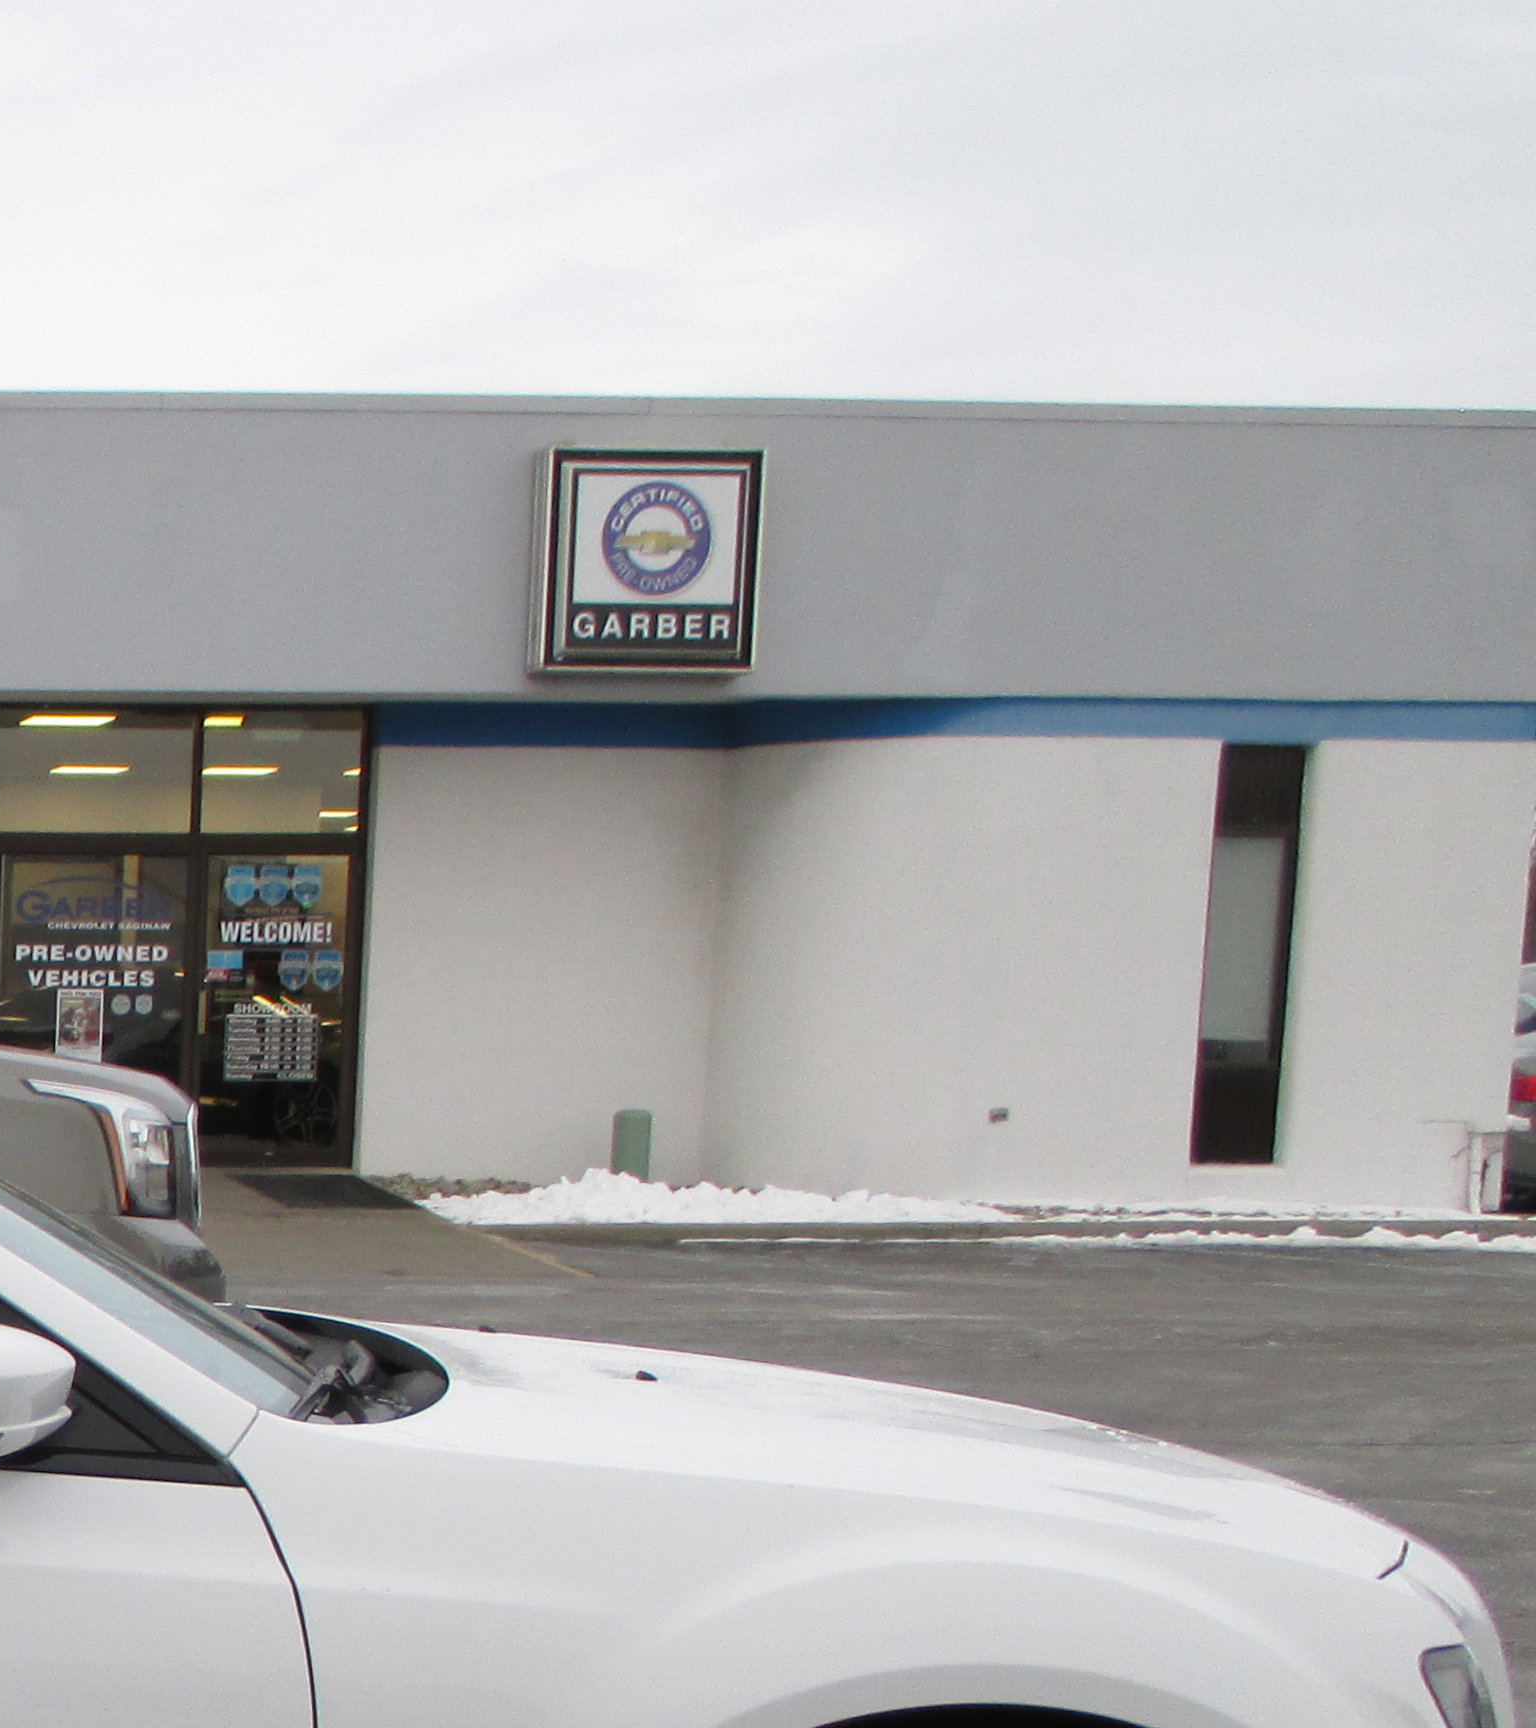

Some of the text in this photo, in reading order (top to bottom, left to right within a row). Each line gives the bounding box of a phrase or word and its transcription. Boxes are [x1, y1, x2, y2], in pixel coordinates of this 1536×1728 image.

[610, 488, 704, 533] CERTIFIED
[572, 612, 731, 640] GARBER
[47, 922, 115, 931] CHEVROLET
[220, 921, 333, 944] WELCOME!
[15, 944, 168, 962] PRE-OWNED
[28, 970, 156, 987] VEHICLES
